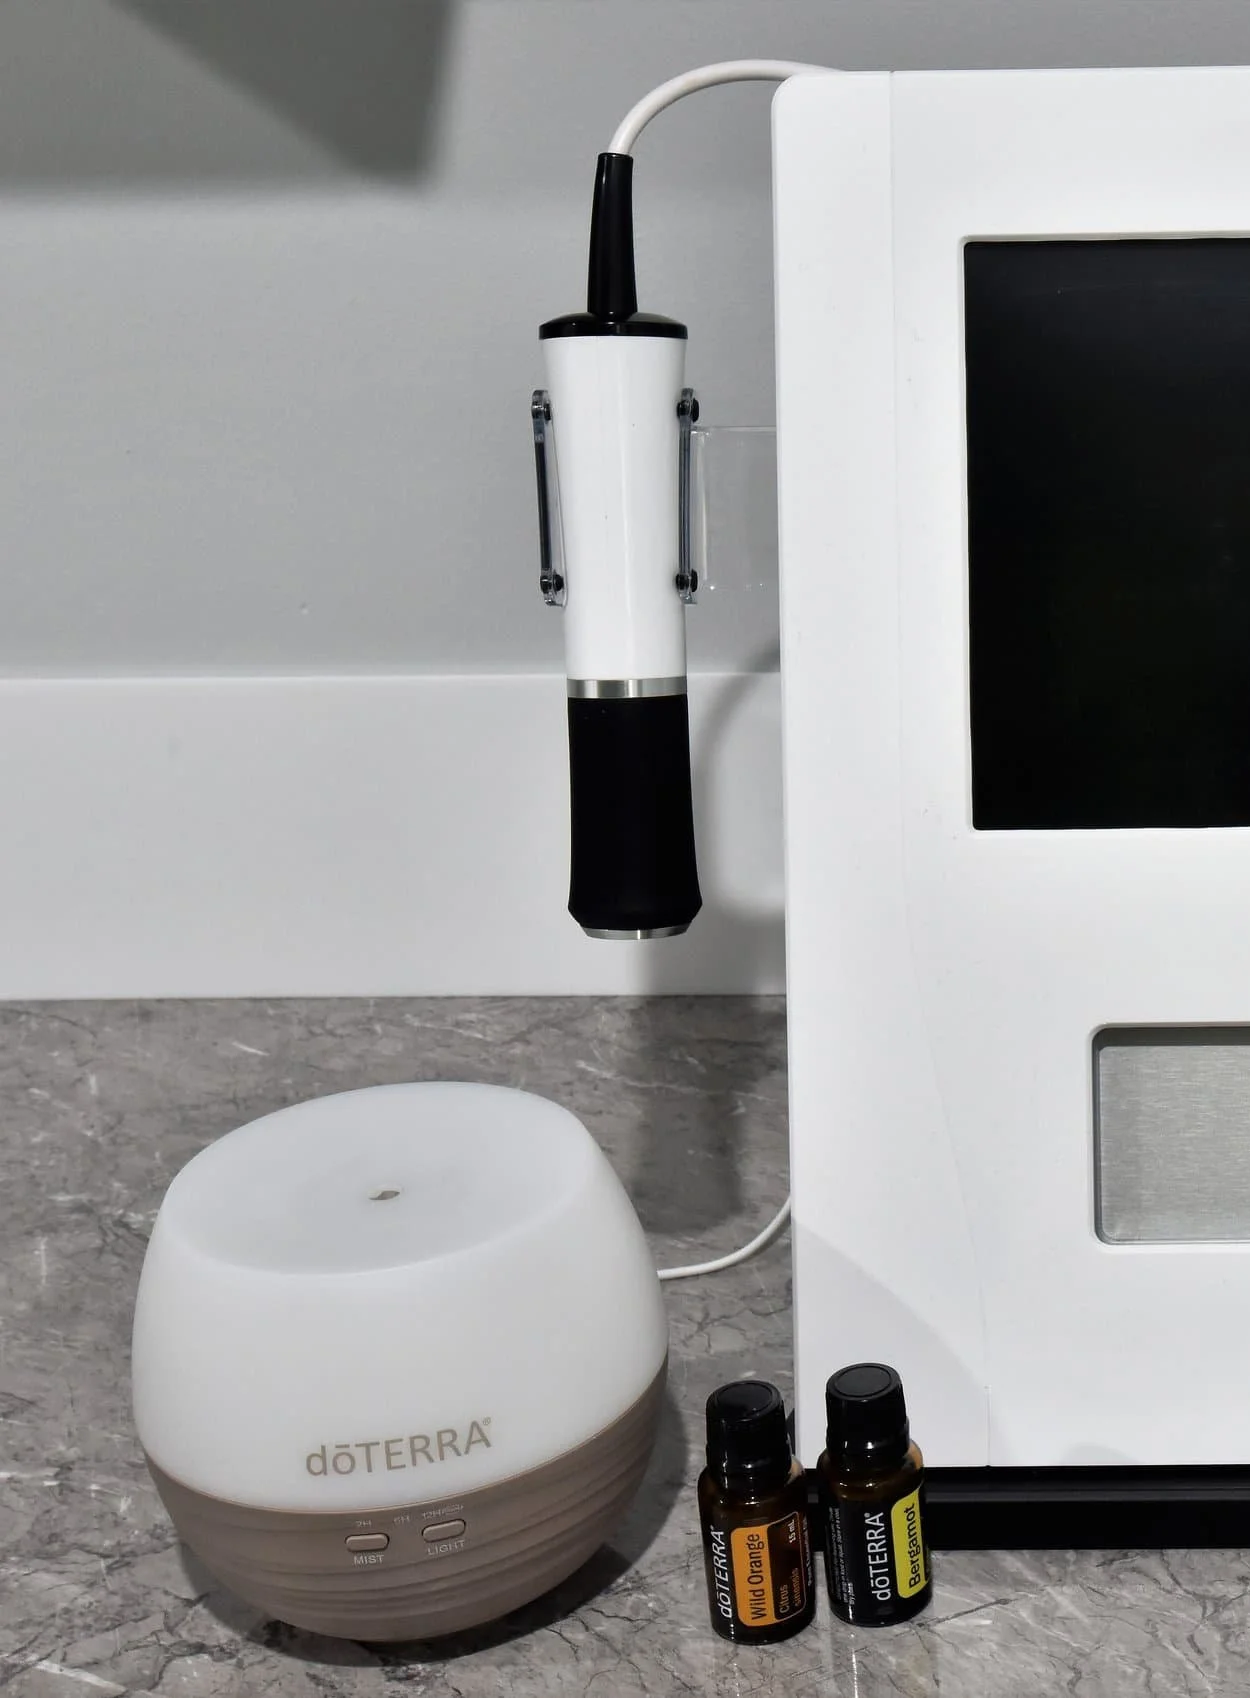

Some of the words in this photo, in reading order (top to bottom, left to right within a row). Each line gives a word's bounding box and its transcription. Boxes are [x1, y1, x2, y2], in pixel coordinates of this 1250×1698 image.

[353, 1554, 385, 1566] MIST
[427, 1539, 466, 1556] LIGHT
[746, 1533, 765, 1585] Orange
[903, 1503, 921, 1589] Bergamot
[748, 1588, 768, 1621] Wild
[779, 1584, 790, 1614] Citrus
